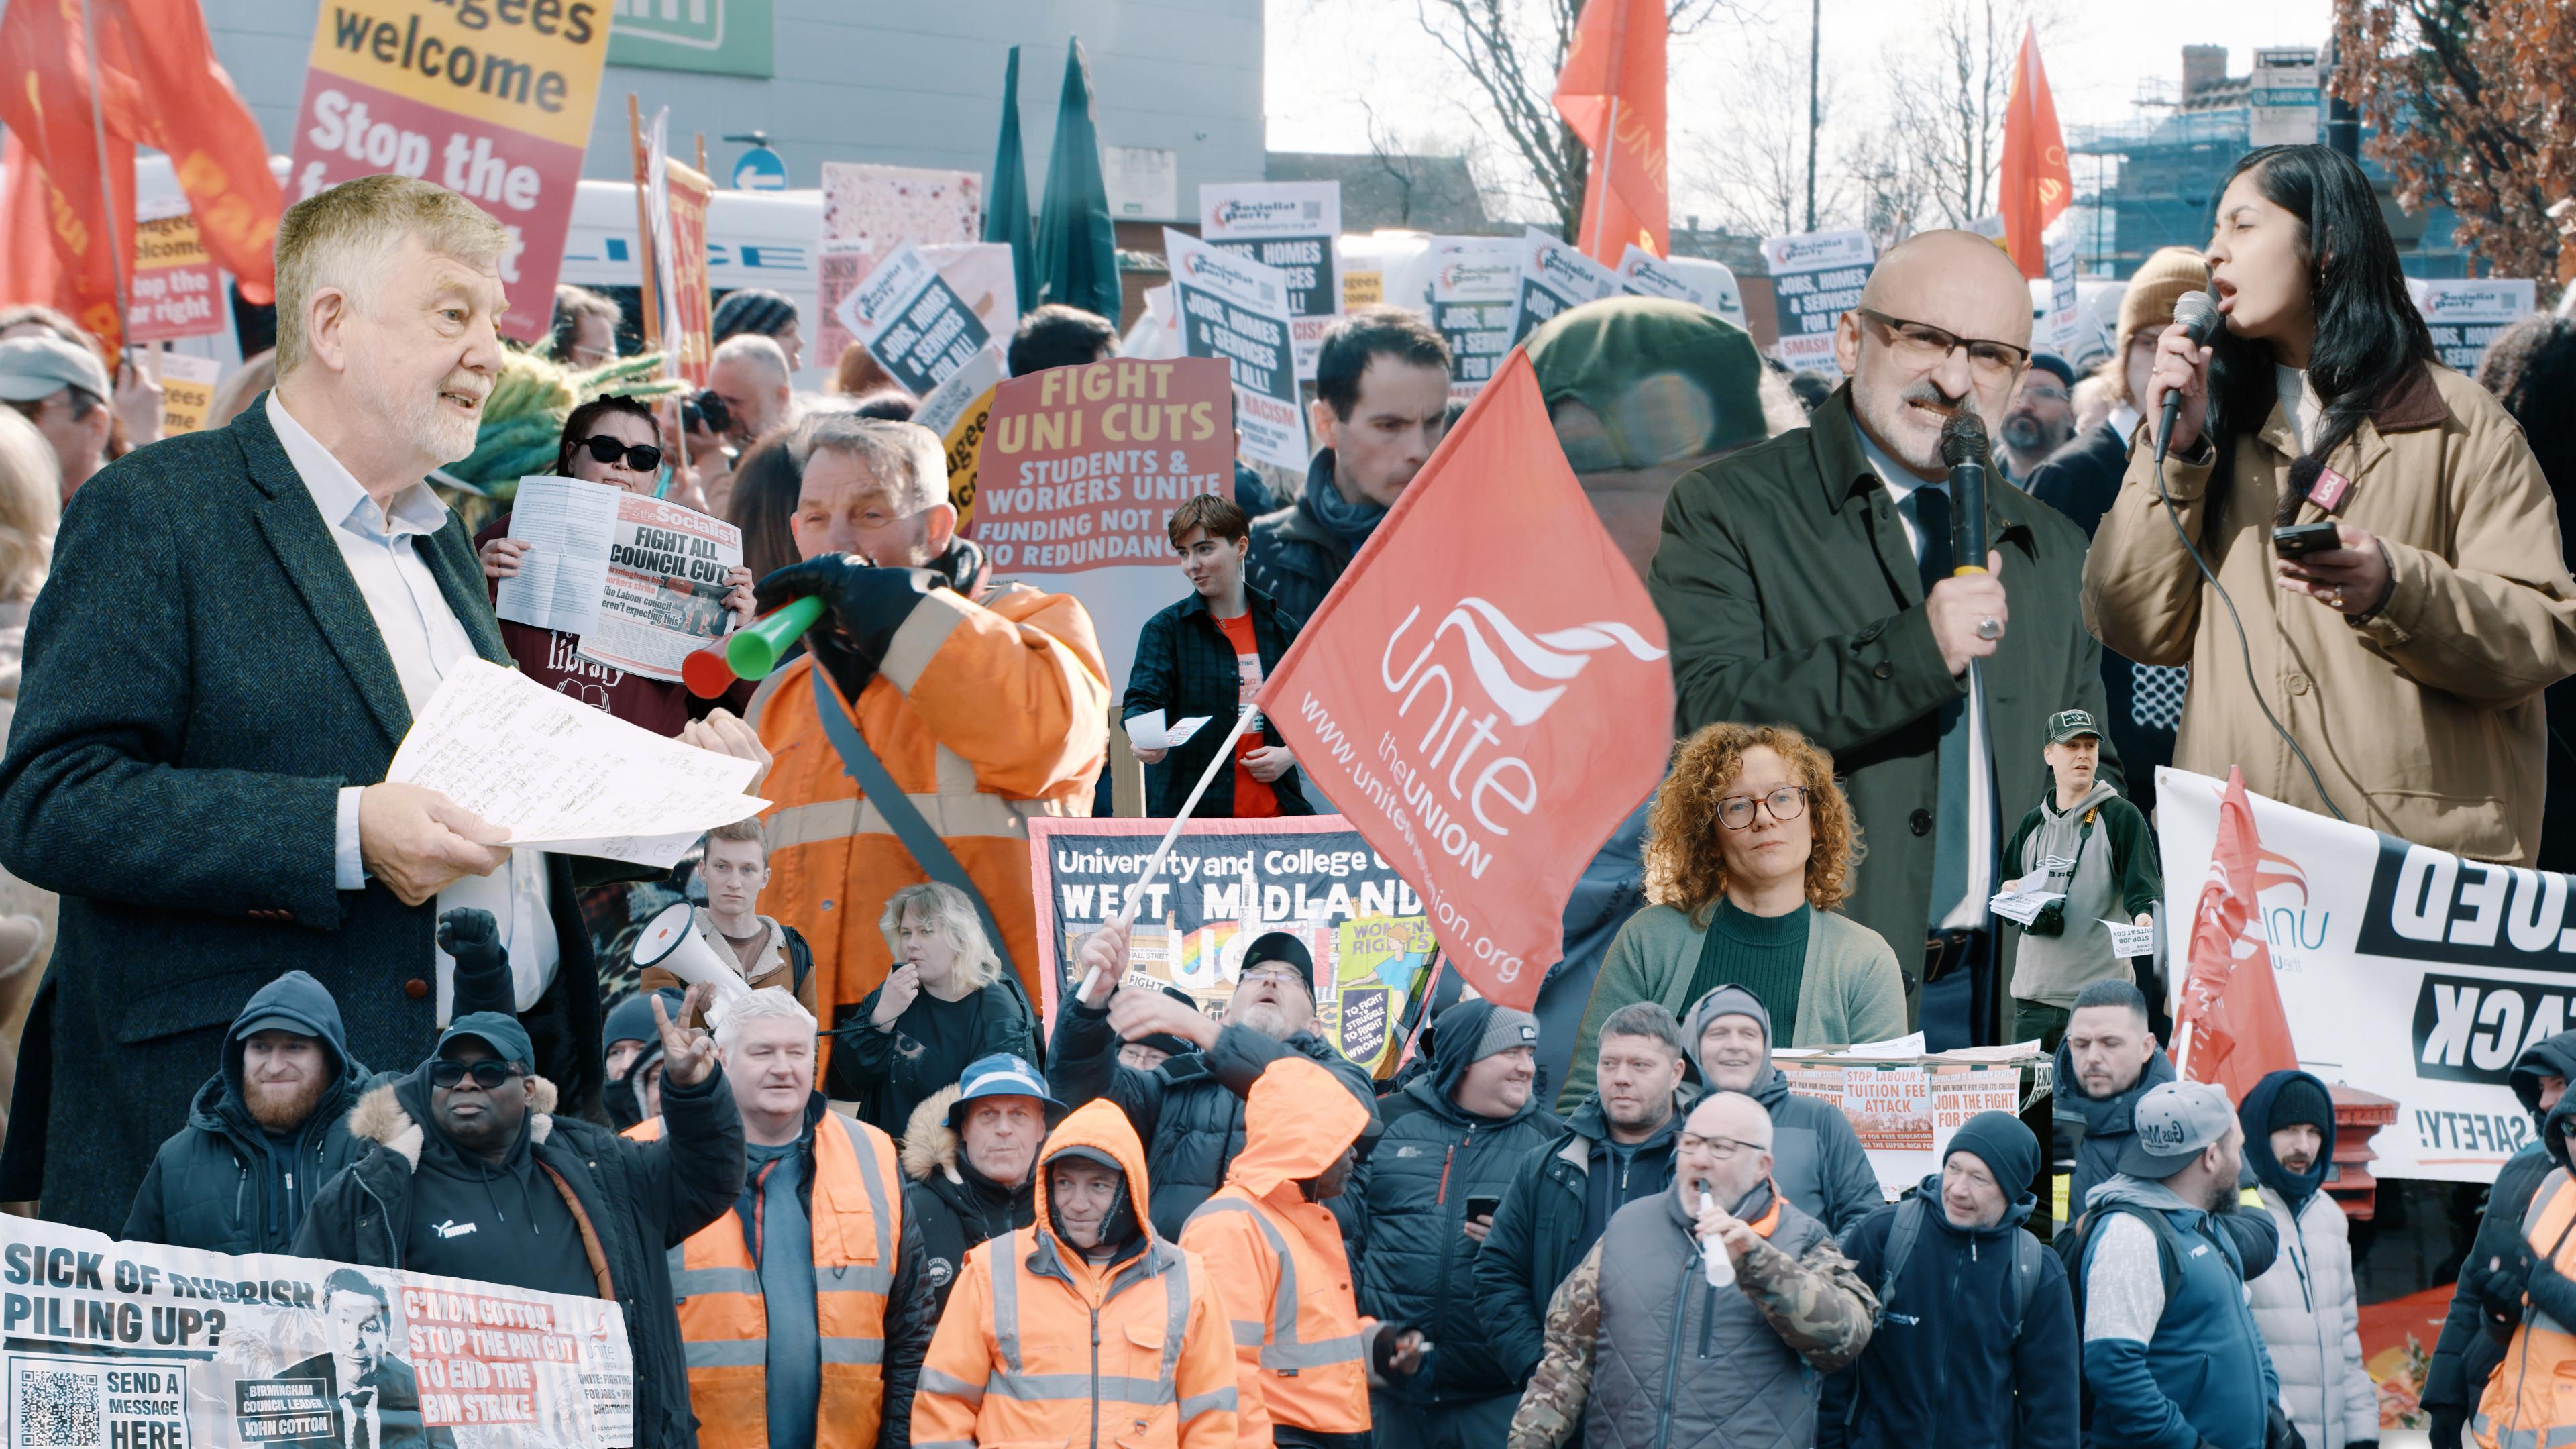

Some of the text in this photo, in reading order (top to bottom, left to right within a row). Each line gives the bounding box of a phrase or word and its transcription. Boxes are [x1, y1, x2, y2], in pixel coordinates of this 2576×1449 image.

[336, 7, 567, 113] welcome
[309, 90, 431, 179] Stop
[443, 133, 541, 211] the
[1263, 242, 1322, 264] HOMES
[1778, 268, 1868, 297] JOBS, HOMES
[155, 296, 212, 325] right
[1801, 313, 1829, 333] FOR
[1228, 307, 1281, 347] HOMES
[1784, 337, 1830, 356] SMASH
[1040, 362, 1174, 407] FIGHT
[1243, 394, 1296, 428] RACISM
[997, 409, 1083, 454] UNI
[1101, 401, 1216, 442] CUTS
[1019, 450, 1189, 486] STUDENTS &
[986, 477, 1122, 515] WORKERS
[1133, 473, 1222, 501] UNITE
[2318, 474, 2341, 502] ucu
[640, 505, 738, 545] the Socialist
[977, 513, 1092, 541] FUNDING
[1100, 509, 1153, 533] NOT
[635, 526, 718, 561] FIGHT ALL
[1022, 535, 1177, 566] REDUNDANC
[610, 544, 733, 585] COUNCIL CUT
[606, 576, 656, 595] orkers strike
[651, 574, 664, 586] bin
[602, 600, 625, 612] eren't
[625, 604, 663, 625] expecting
[616, 590, 672, 612] Labour council
[1382, 604, 1537, 836] unite
[1203, 851, 1253, 877] and
[1264, 849, 1368, 877] College
[1129, 975, 1165, 991] FIGHT
[1345, 993, 1383, 1018] TO FIGHT
[1344, 1018, 1383, 1042] TO RIGHT
[1346, 1007, 1385, 1030] STRUGGLE
[1346, 1034, 1383, 1059] WRONG
[1358, 1032, 1373, 1042] THE
[1827, 1084, 1843, 1092] CRISIS
[1847, 1071, 1925, 1083] STOP LABOUR'S
[1932, 1085, 1943, 1093] BUT
[1952, 1084, 1967, 1092] WON'T
[1968, 1083, 1977, 1091] PAY
[1978, 1083, 1988, 1091] FOR
[1998, 1083, 2015, 1091] CRISIS
[1848, 1084, 1927, 1097] TUITION FEE
[1934, 1093, 2015, 1110] JOIN THE FIGHT
[1865, 1099, 1911, 1113] ATTACK
[1939, 1112, 1960, 1128] FOR
[4, 1242, 105, 1291] SICK
[114, 1260, 161, 1295] OF
[4, 1292, 227, 1346] PILING UP?
[403, 1290, 554, 1336] C'MON COTTON,
[408, 1324, 574, 1362] STOP THE PAY CUT
[107, 1371, 179, 1395] SEND A
[414, 1358, 531, 1389] TO END THE
[578, 1373, 633, 1385] UNITE: FIGHTING
[249, 1385, 313, 1397] BIRMINGHAM
[584, 1389, 633, 1400] FOR JOBS PAY
[109, 1398, 179, 1416] MESSAGE
[243, 1398, 324, 1413] COUNCIL LEADER
[421, 1393, 533, 1424] BIN STRIKE
[111, 1420, 182, 1449] HERE
[245, 1416, 328, 1436] JOHN COTTON
